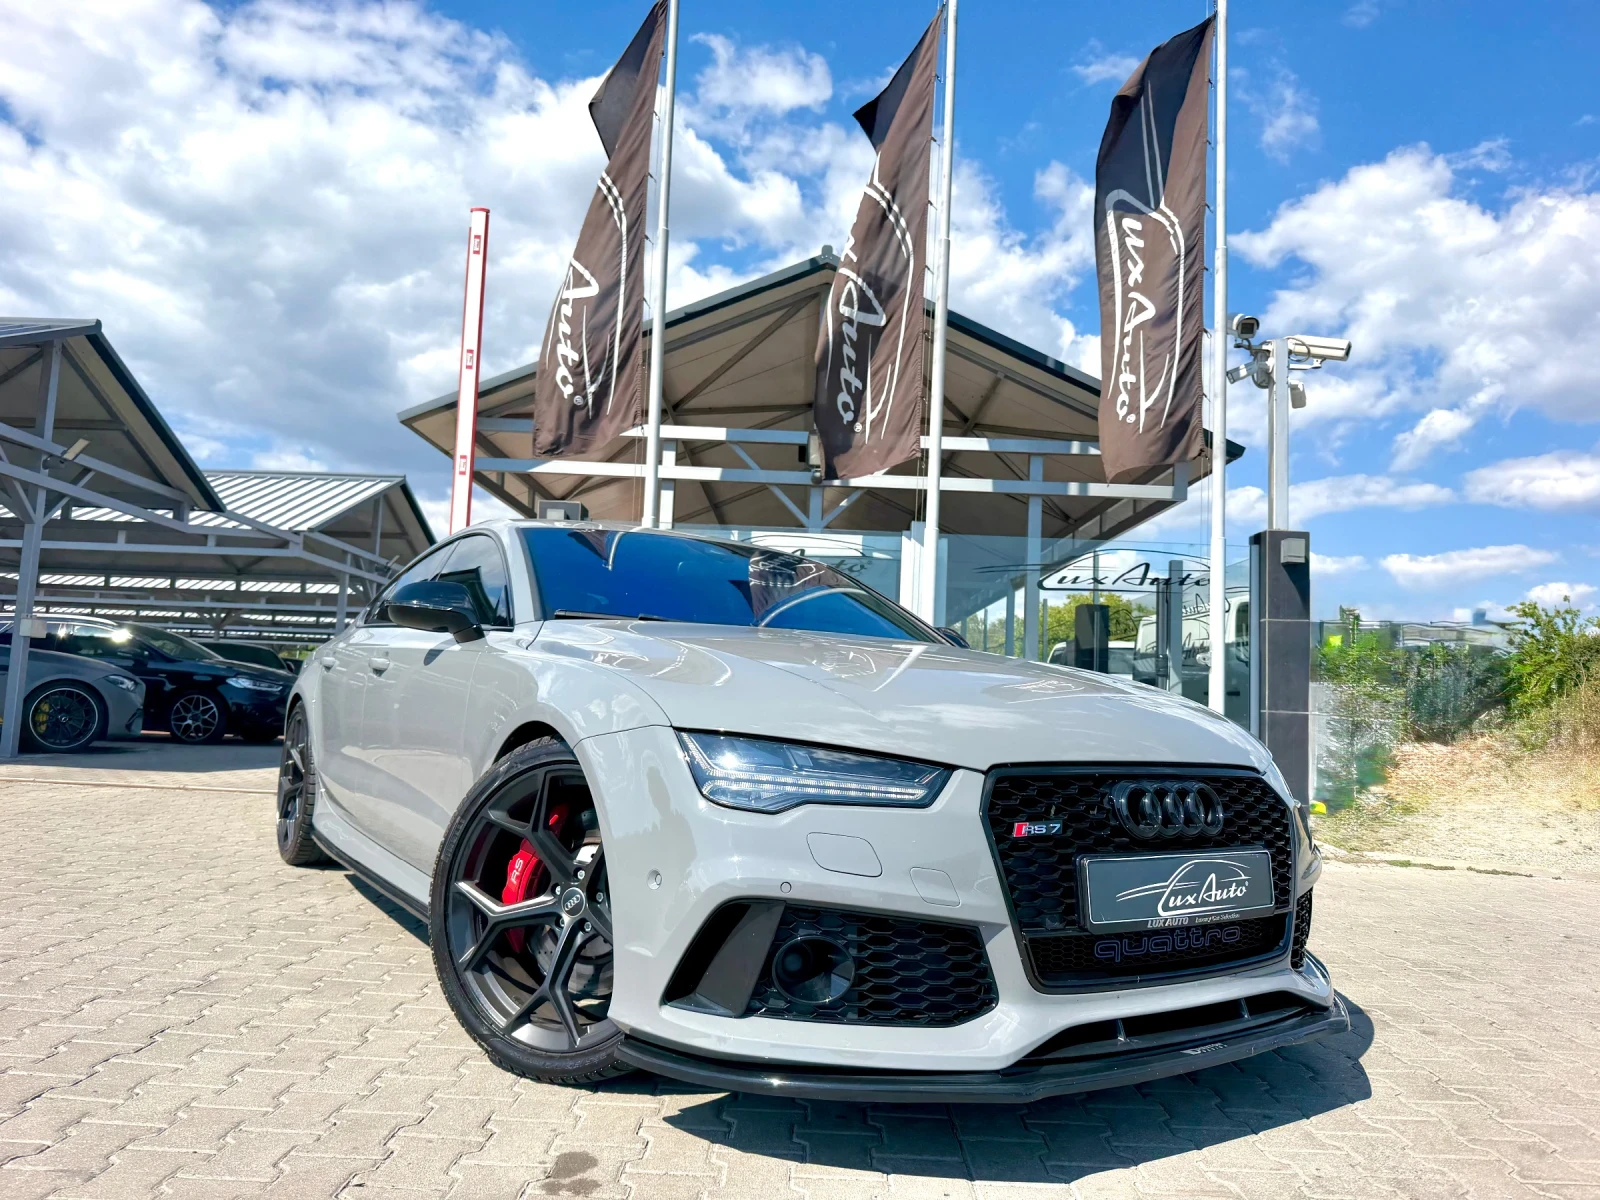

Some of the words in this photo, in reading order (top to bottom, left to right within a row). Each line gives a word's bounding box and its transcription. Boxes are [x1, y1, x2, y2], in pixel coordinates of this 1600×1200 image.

[511, 857, 524, 885] RS
[1147, 918, 1164, 928] LUX
[1165, 917, 1189, 927] AUTO
[1094, 925, 1241, 963] quattro
